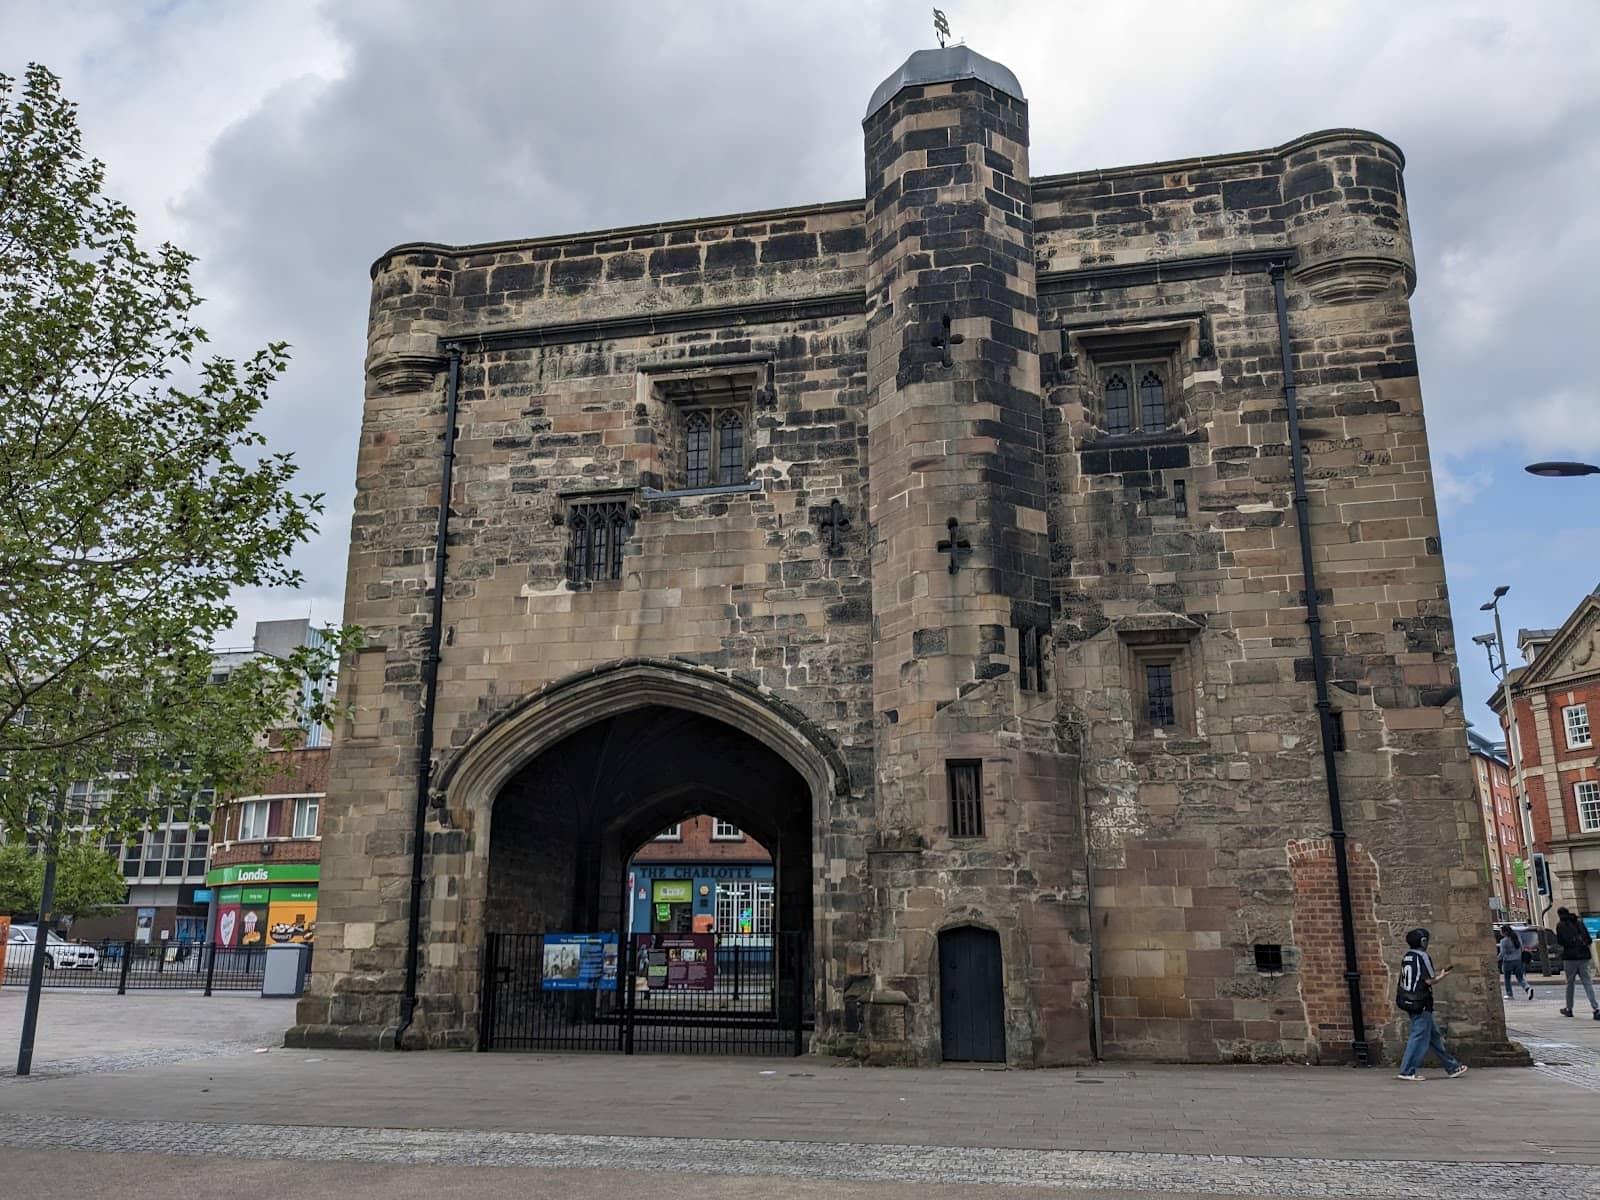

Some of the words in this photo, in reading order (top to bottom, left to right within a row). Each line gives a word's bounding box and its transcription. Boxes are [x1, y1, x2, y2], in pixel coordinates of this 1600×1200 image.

[238, 868, 268, 880] Londis
[640, 868, 666, 878] THE
[673, 867, 752, 878] CHARLOTTE
